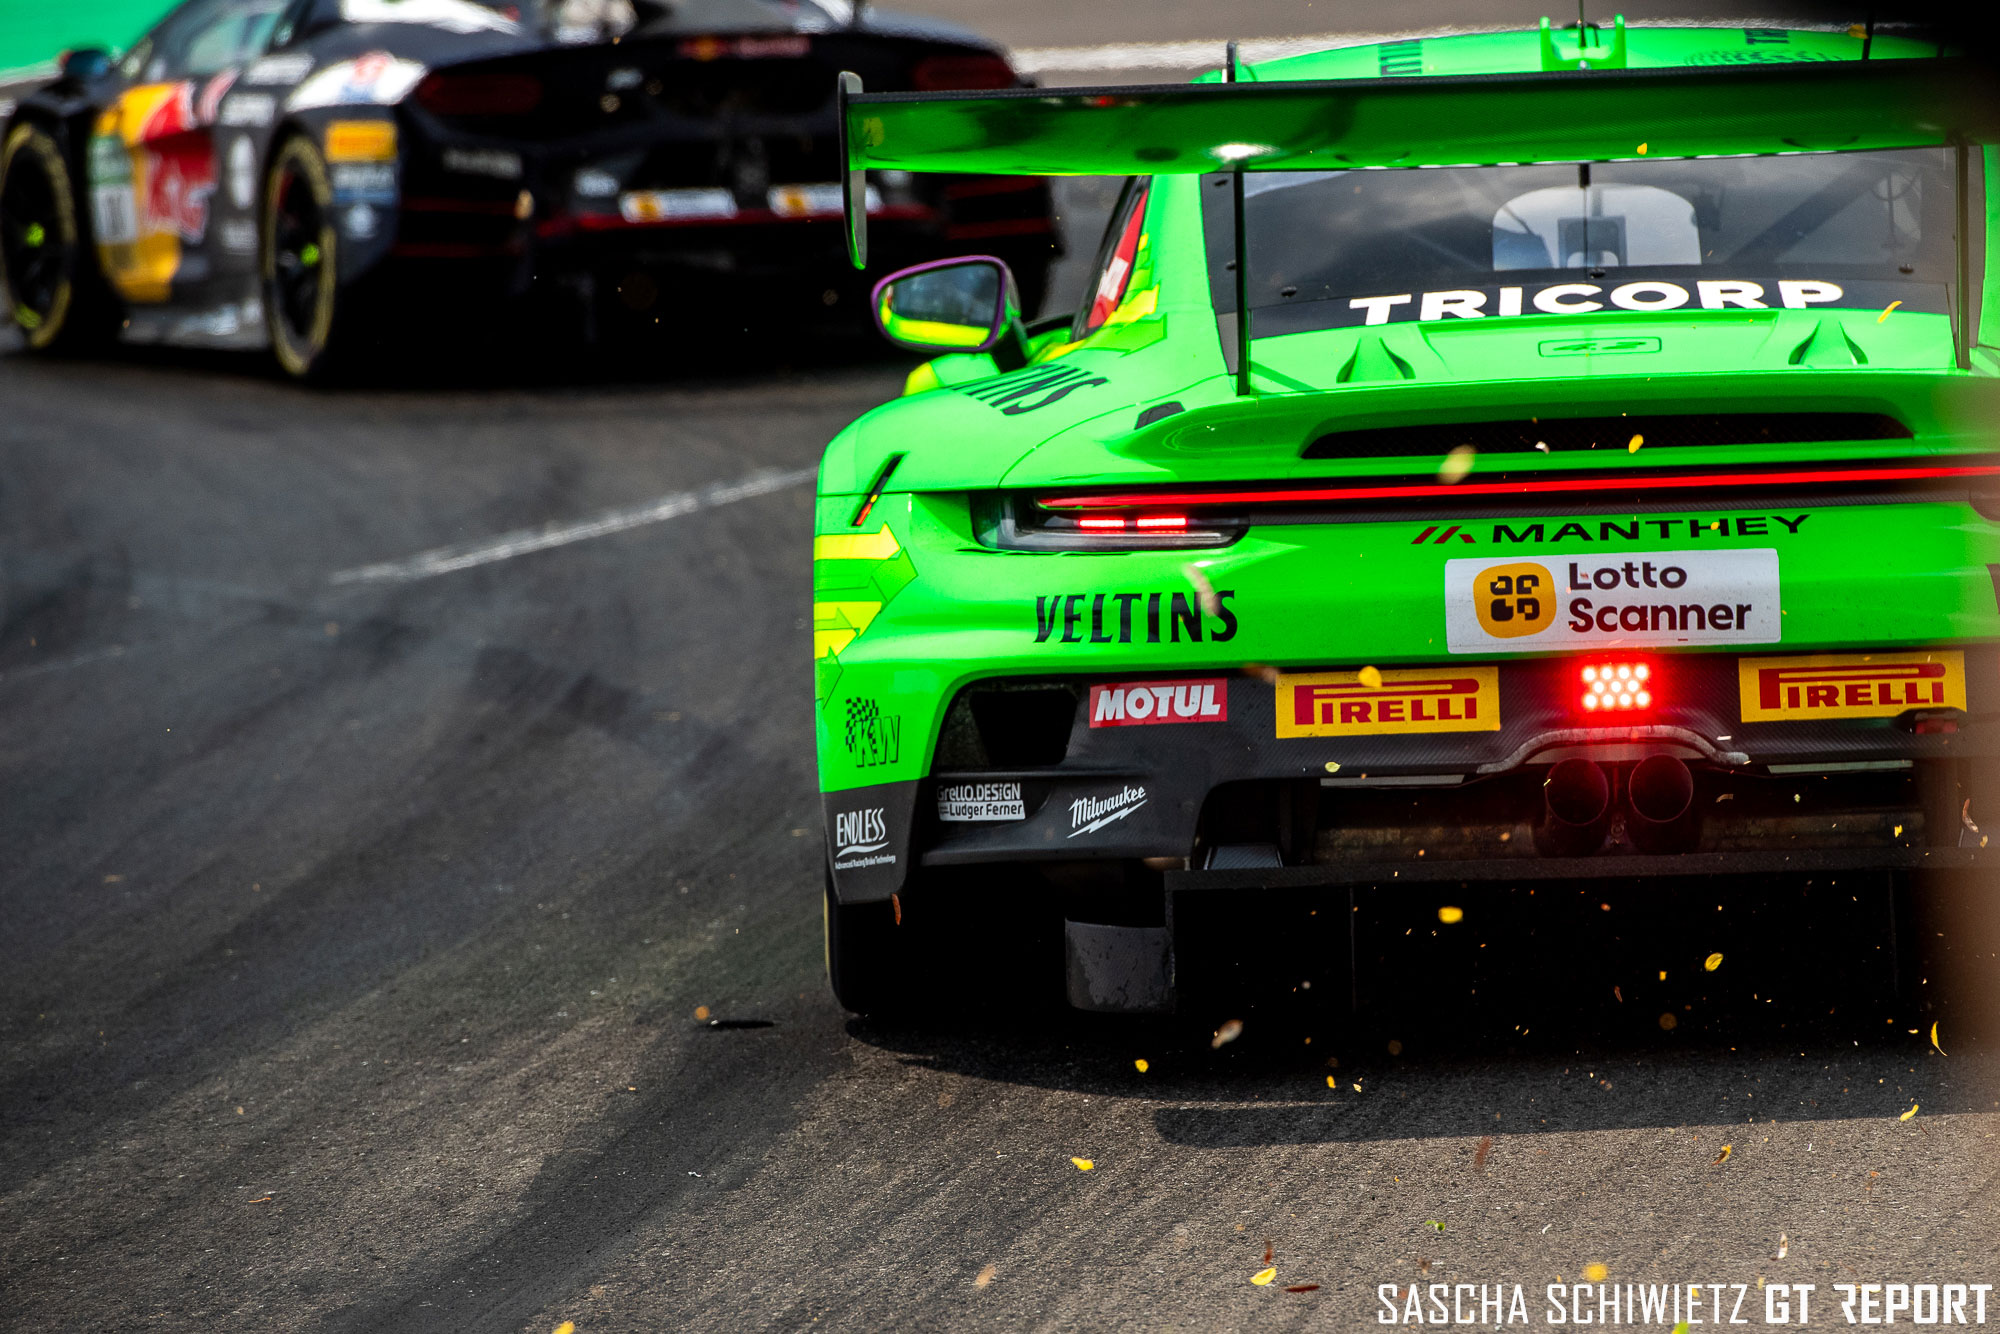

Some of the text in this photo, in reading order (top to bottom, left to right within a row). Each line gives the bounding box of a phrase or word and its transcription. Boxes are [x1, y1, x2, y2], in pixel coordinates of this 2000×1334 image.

[1349, 280, 1844, 326] TRICORP
[1492, 513, 1811, 544] MANTHEY
[1568, 560, 1688, 591] Lotto
[1033, 584, 1239, 643] VELTINS
[1567, 597, 1753, 633] Scanner
[1094, 684, 1222, 722] MOTUL
[1293, 678, 1480, 726] PIRELLI
[1758, 662, 1946, 710] PIRELLI
[836, 807, 886, 847] ENDLESS
[950, 803, 984, 820] Ludger
[985, 802, 1023, 816] Ferner
[1067, 785, 1147, 829] Milwaukee
